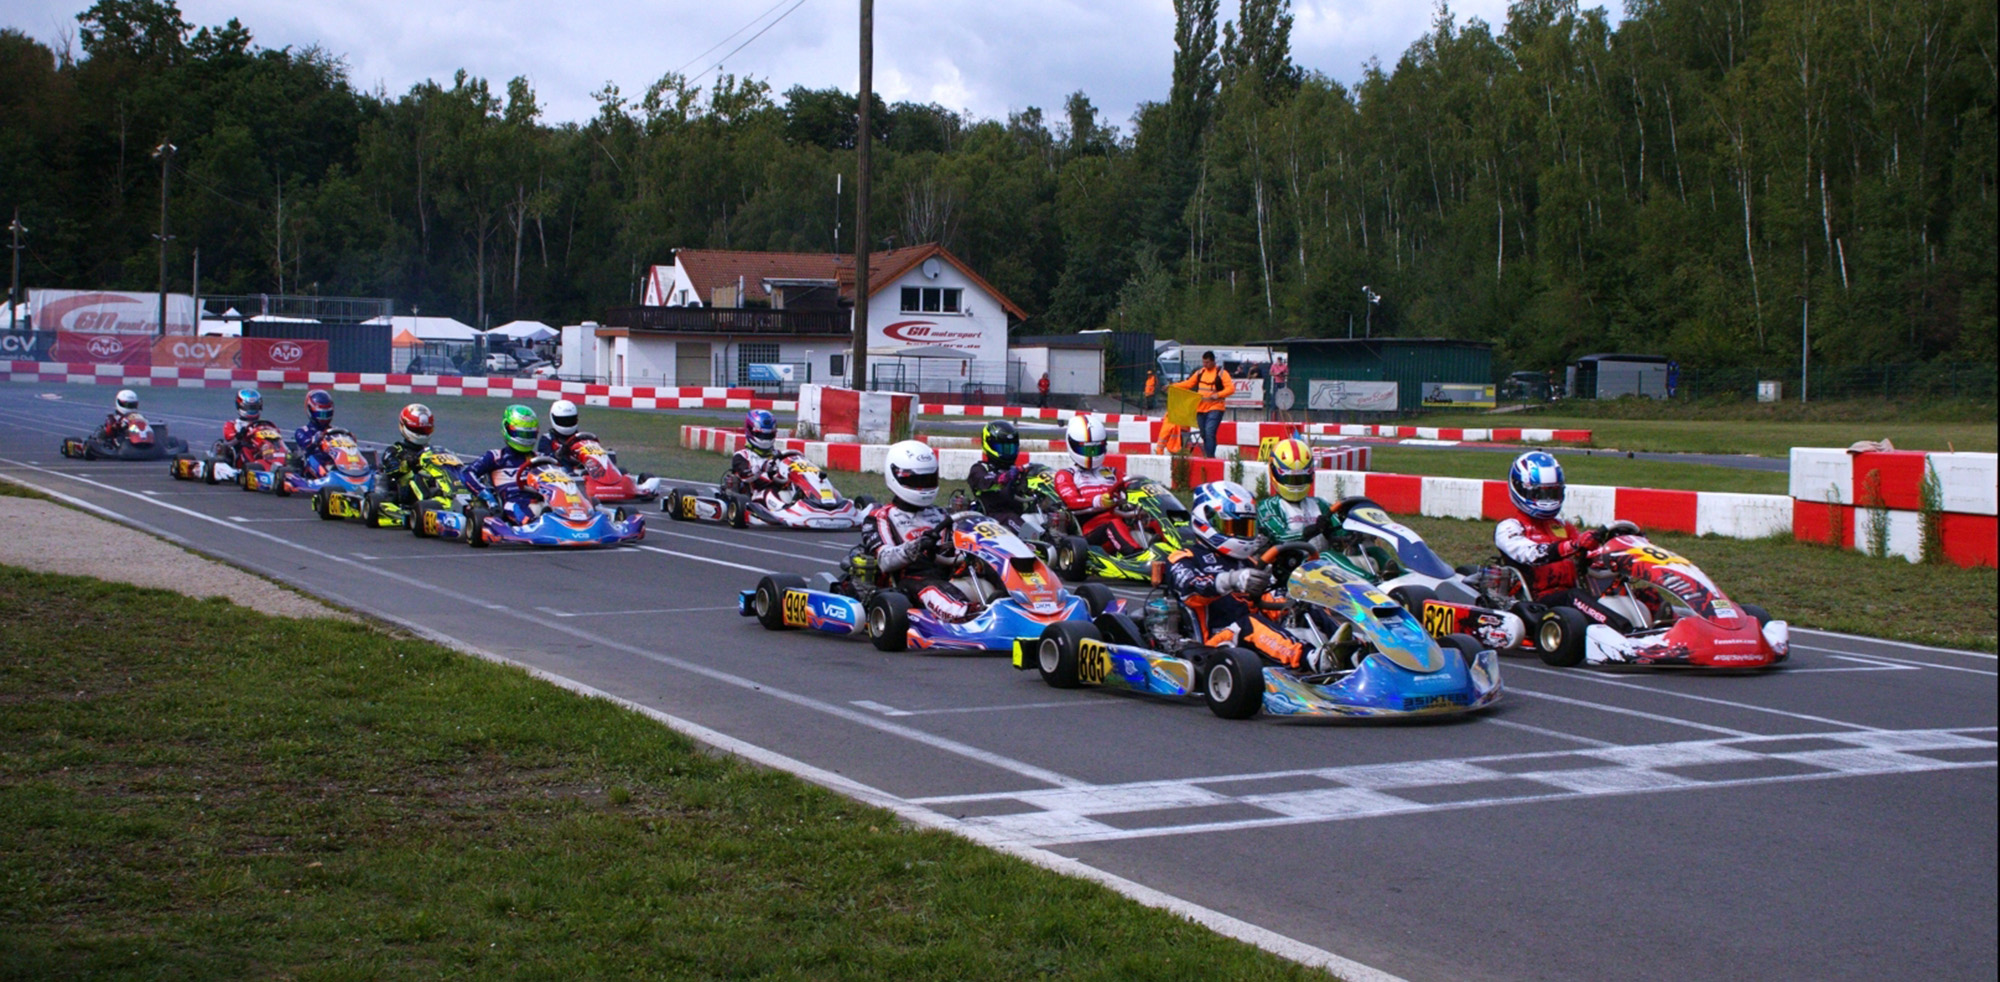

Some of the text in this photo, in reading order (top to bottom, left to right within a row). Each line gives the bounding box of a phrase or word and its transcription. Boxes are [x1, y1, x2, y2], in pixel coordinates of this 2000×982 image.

[931, 331, 982, 339] motorsport
[785, 593, 807, 624] 998
[822, 602, 847, 619] VDB
[1425, 605, 1454, 639] 820
[1574, 598, 1607, 623] MAURER
[1080, 643, 1106, 683] 885
